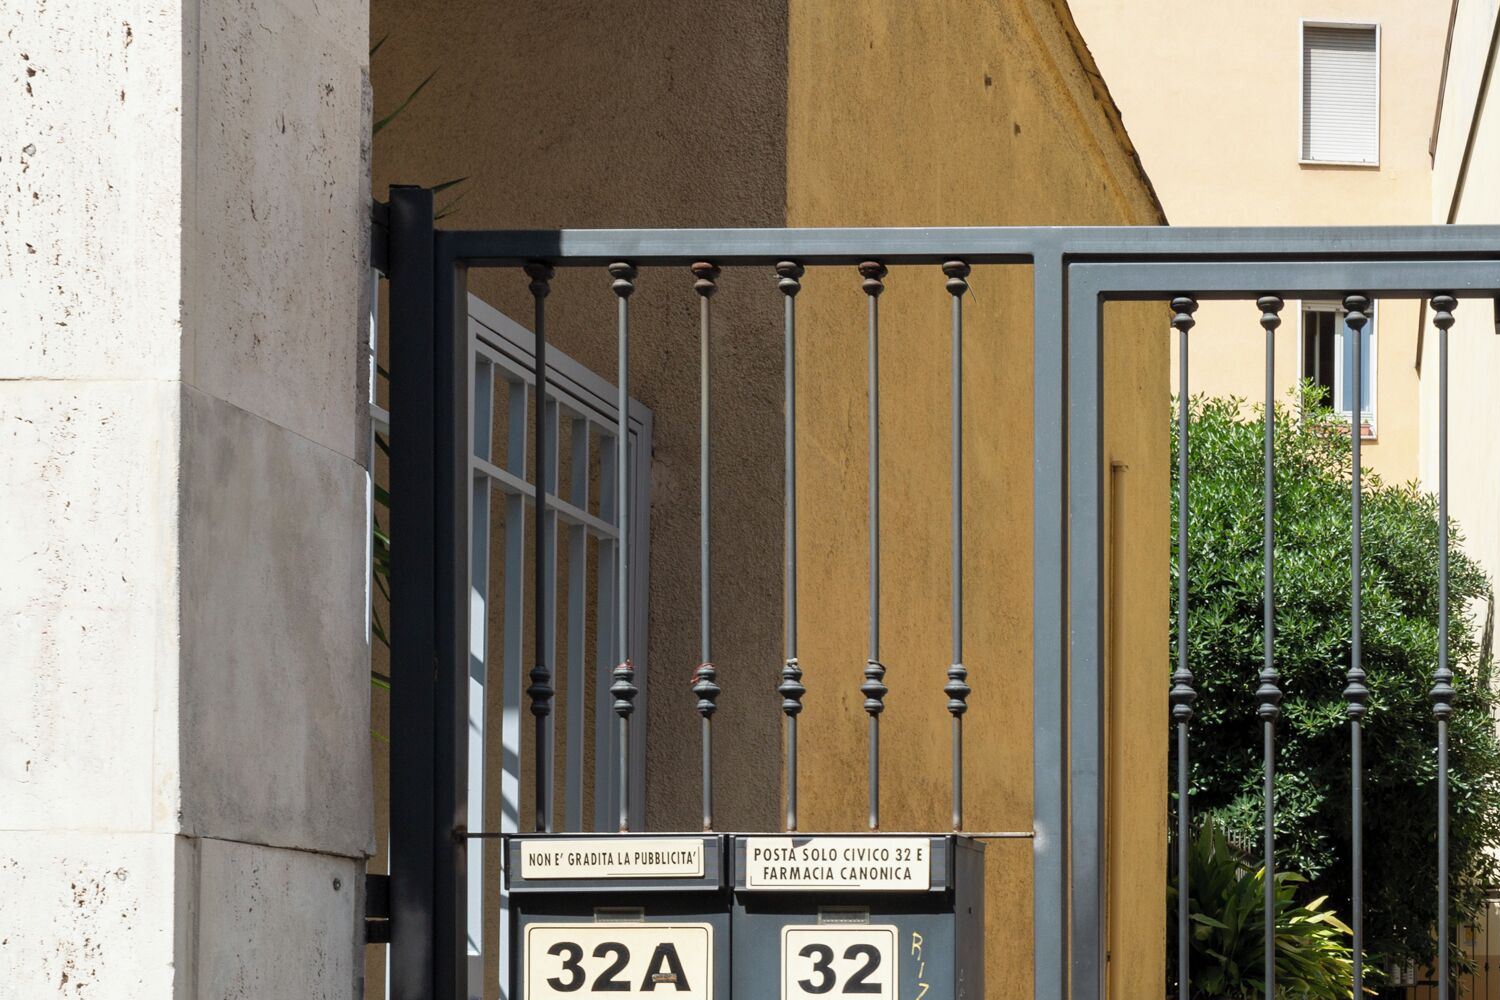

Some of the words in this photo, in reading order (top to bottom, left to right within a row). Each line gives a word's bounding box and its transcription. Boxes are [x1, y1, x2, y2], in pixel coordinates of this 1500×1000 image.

[529, 853, 550, 866] NON
[555, 853, 564, 865] E'
[568, 852, 614, 865] GRADITA
[618, 852, 630, 865] LA
[635, 851, 696, 865] PUBBLICITA'
[754, 848, 796, 861] POSTA
[803, 848, 837, 861] SOLO
[844, 848, 889, 861] CIVICO
[895, 848, 910, 861] 32
[917, 848, 922, 861] E
[764, 867, 834, 880] FARMACIA
[840, 867, 912, 880] CANONICA
[546, 941, 691, 992] 32A
[797, 944, 882, 994] 32
